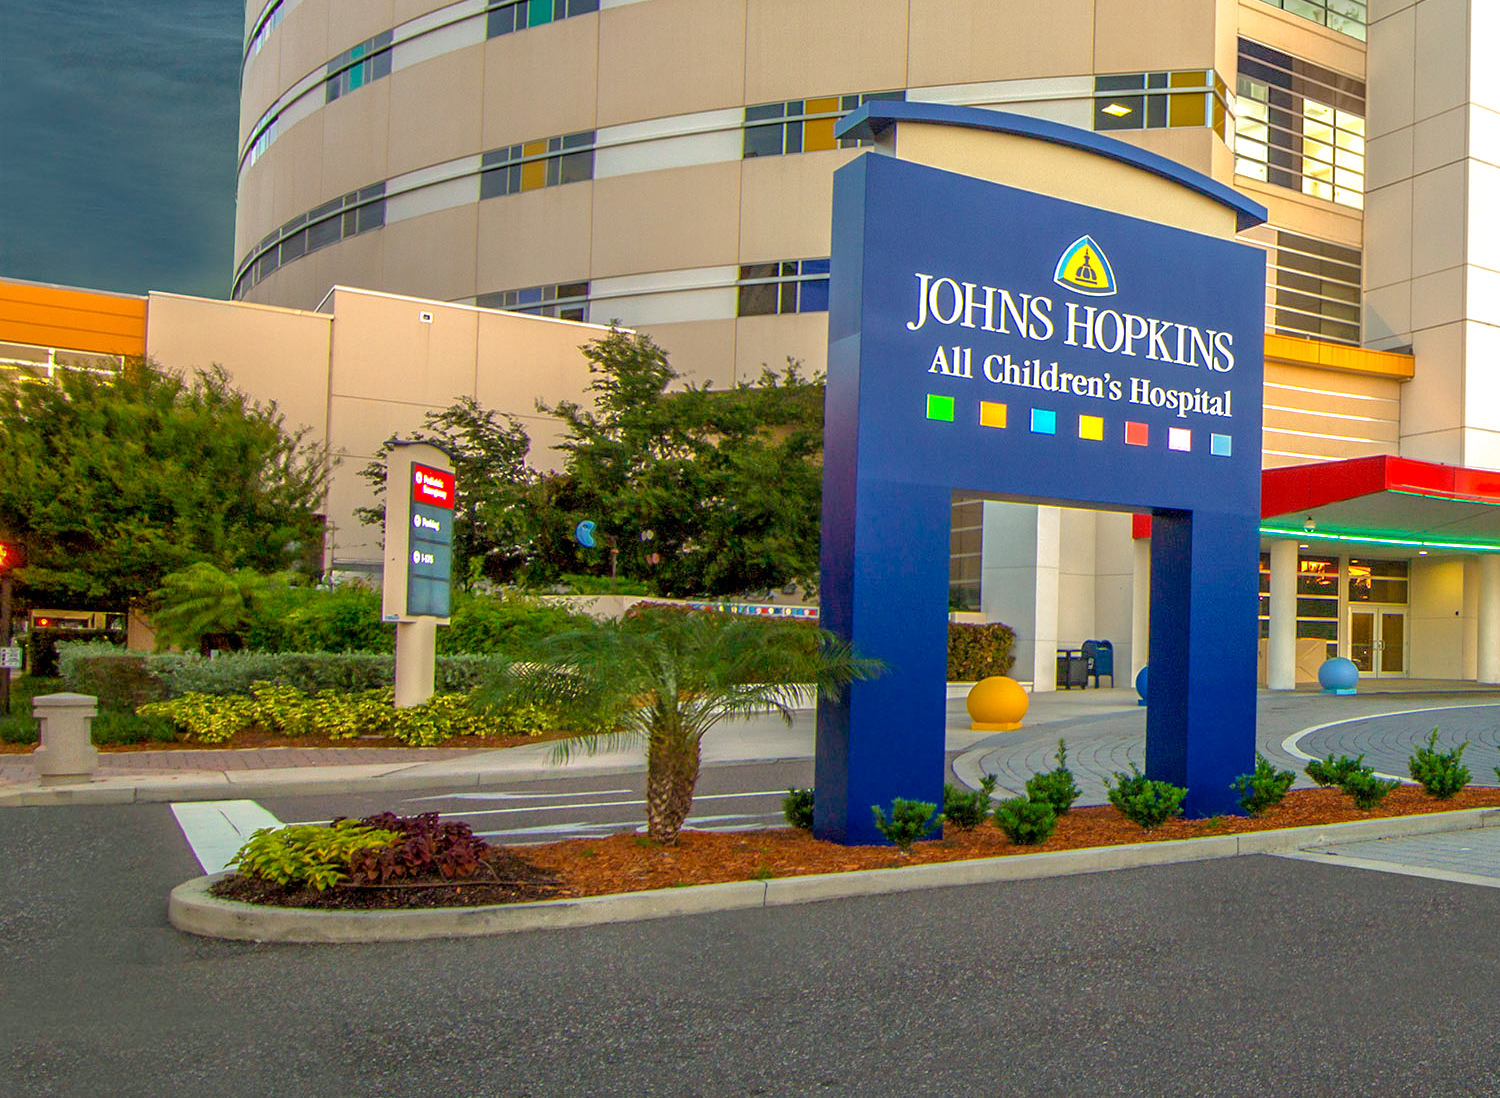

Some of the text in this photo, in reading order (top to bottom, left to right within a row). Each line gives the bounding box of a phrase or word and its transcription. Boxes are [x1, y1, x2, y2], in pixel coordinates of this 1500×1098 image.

[906, 272, 1235, 373] JOHNS HOPKINS
[928, 345, 1232, 417] All Children's Hospital
